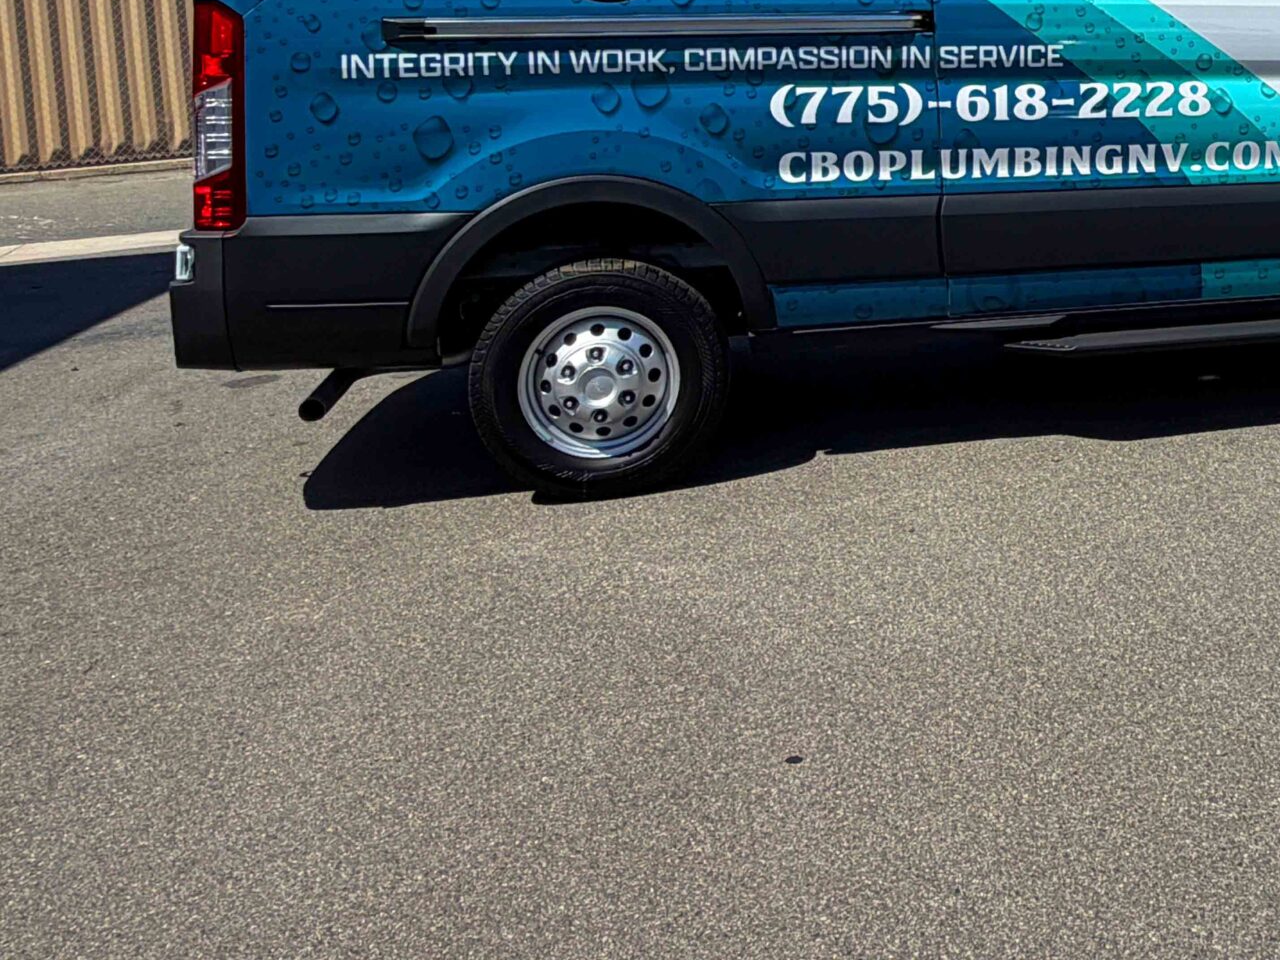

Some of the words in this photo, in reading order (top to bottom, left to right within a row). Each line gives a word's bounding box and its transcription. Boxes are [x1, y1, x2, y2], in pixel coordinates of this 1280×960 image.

[341, 51, 517, 79] INTEGRITY
[528, 49, 560, 75] IN
[569, 48, 677, 75] WORK,
[684, 45, 893, 71] COMPASSION
[902, 44, 930, 69] IN
[940, 44, 1064, 69] SERVICE
[769, 80, 1212, 127] (775)-618-2228
